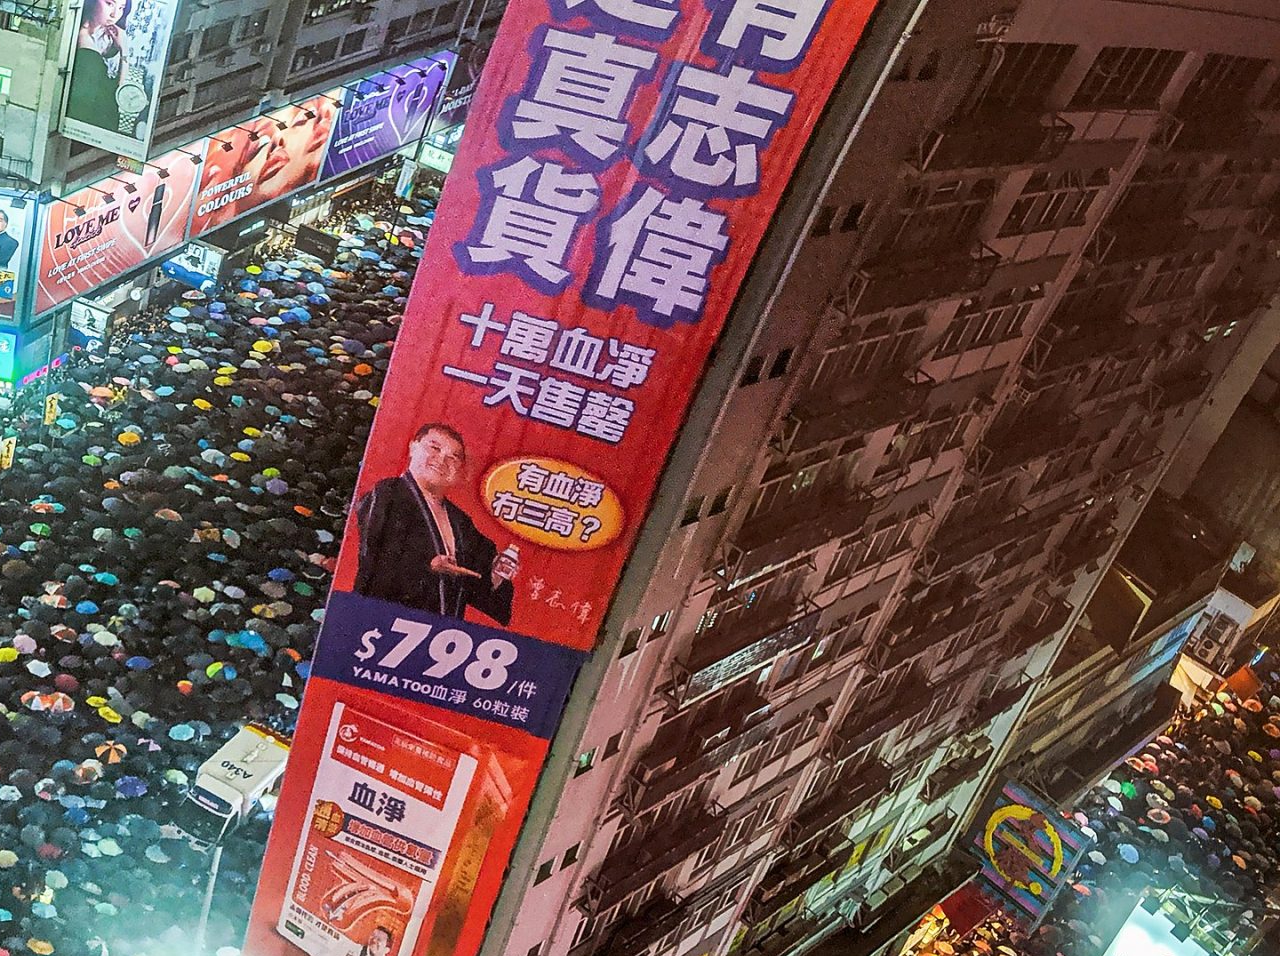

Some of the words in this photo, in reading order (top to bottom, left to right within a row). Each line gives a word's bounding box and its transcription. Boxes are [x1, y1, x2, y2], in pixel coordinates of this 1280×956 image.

[469, 0, 679, 284] 真貨
[197, 182, 254, 216] COLOURS
[200, 170, 251, 201] POWERFUL
[54, 218, 95, 249] LOVE
[99, 206, 120, 227] ME
[460, 303, 658, 391] 十萬血淨
[444, 363, 634, 444] 一天售罄
[516, 463, 605, 507] 有血淨
[473, 698, 531, 723] 60粒裝
[221, 760, 253, 779] A340
[347, 781, 407, 823] 血淨
[296, 872, 312, 903] BLOOD
[304, 844, 319, 873] CLEAN
